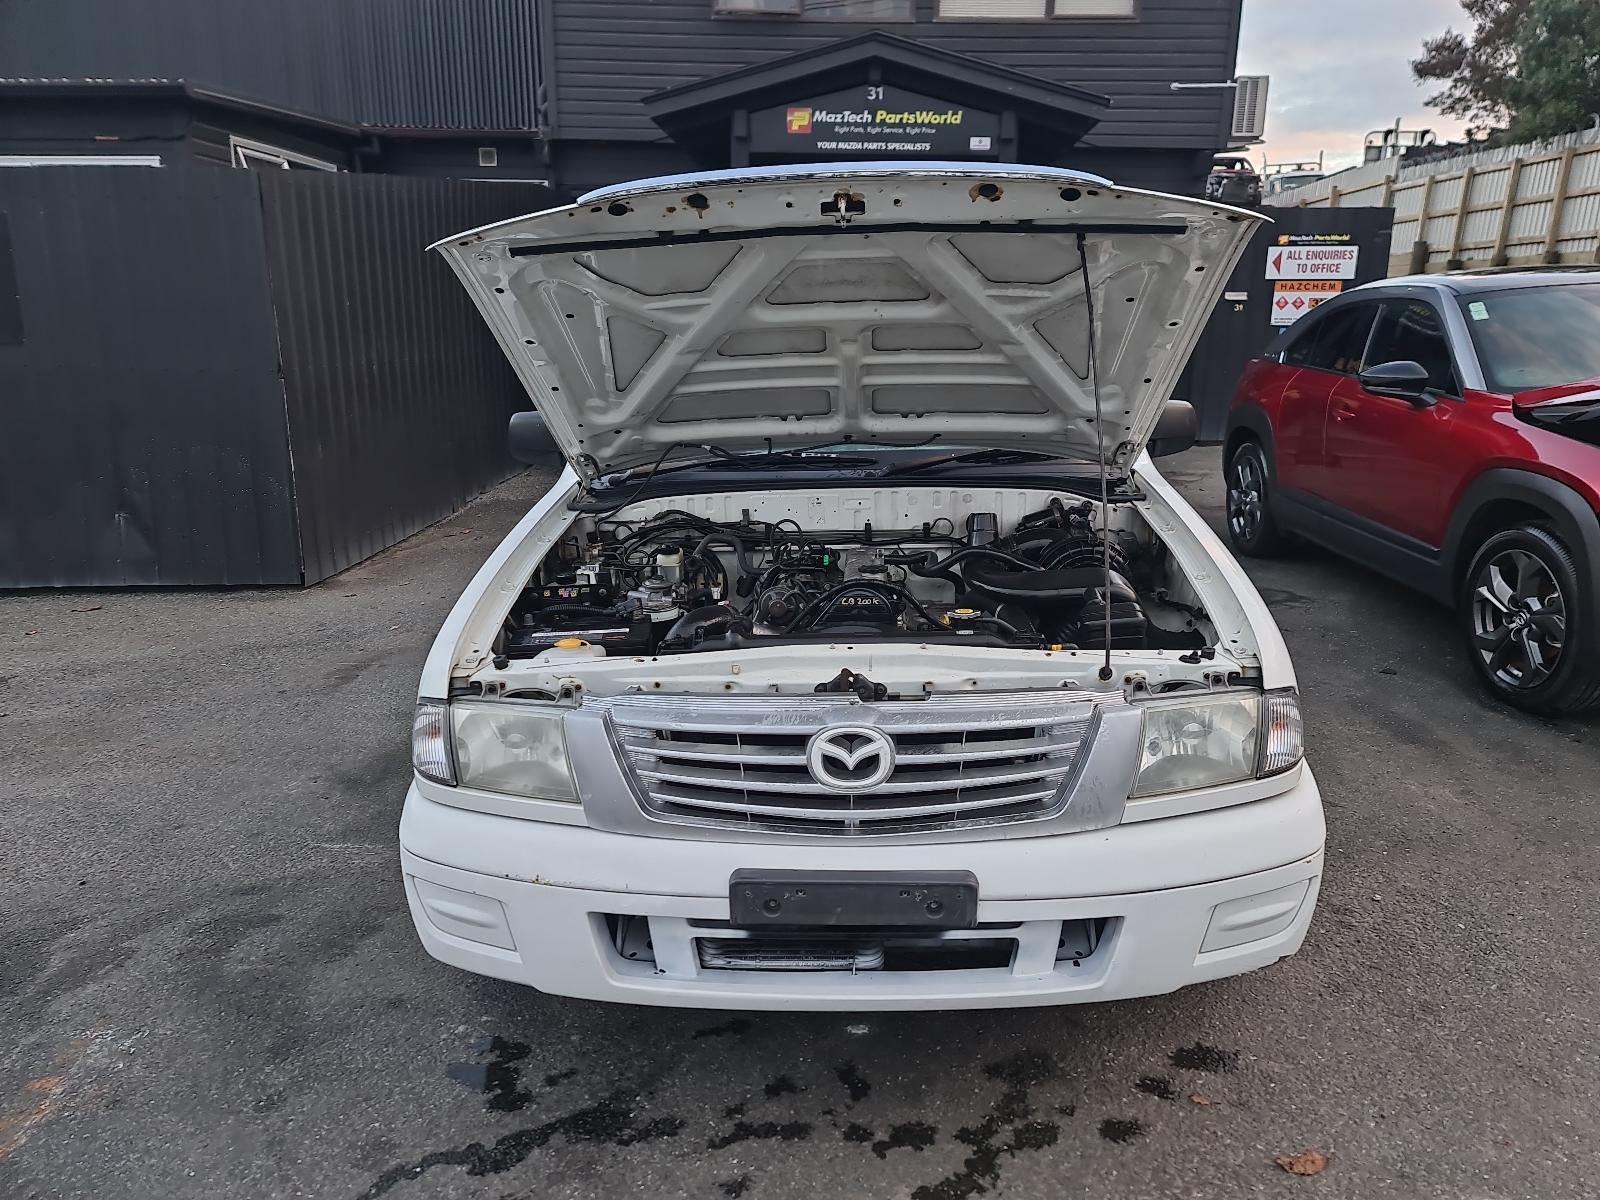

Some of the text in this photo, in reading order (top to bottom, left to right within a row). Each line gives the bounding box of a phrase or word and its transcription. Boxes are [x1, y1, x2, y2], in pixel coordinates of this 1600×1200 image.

[867, 86, 884, 100] 31
[813, 110, 963, 124] MazTech PartsWorld
[834, 125, 849, 134] Right
[867, 126, 882, 134] Right
[905, 127, 920, 135] Right
[817, 141, 837, 149] YOUR
[863, 142, 886, 150] PARTS
[887, 143, 931, 151] SPECIALISTS
[1286, 249, 1355, 261] ALL ENQUIRIES
[1296, 263, 1342, 274] TO OFFICE
[1280, 282, 1337, 291] HAZCHEM
